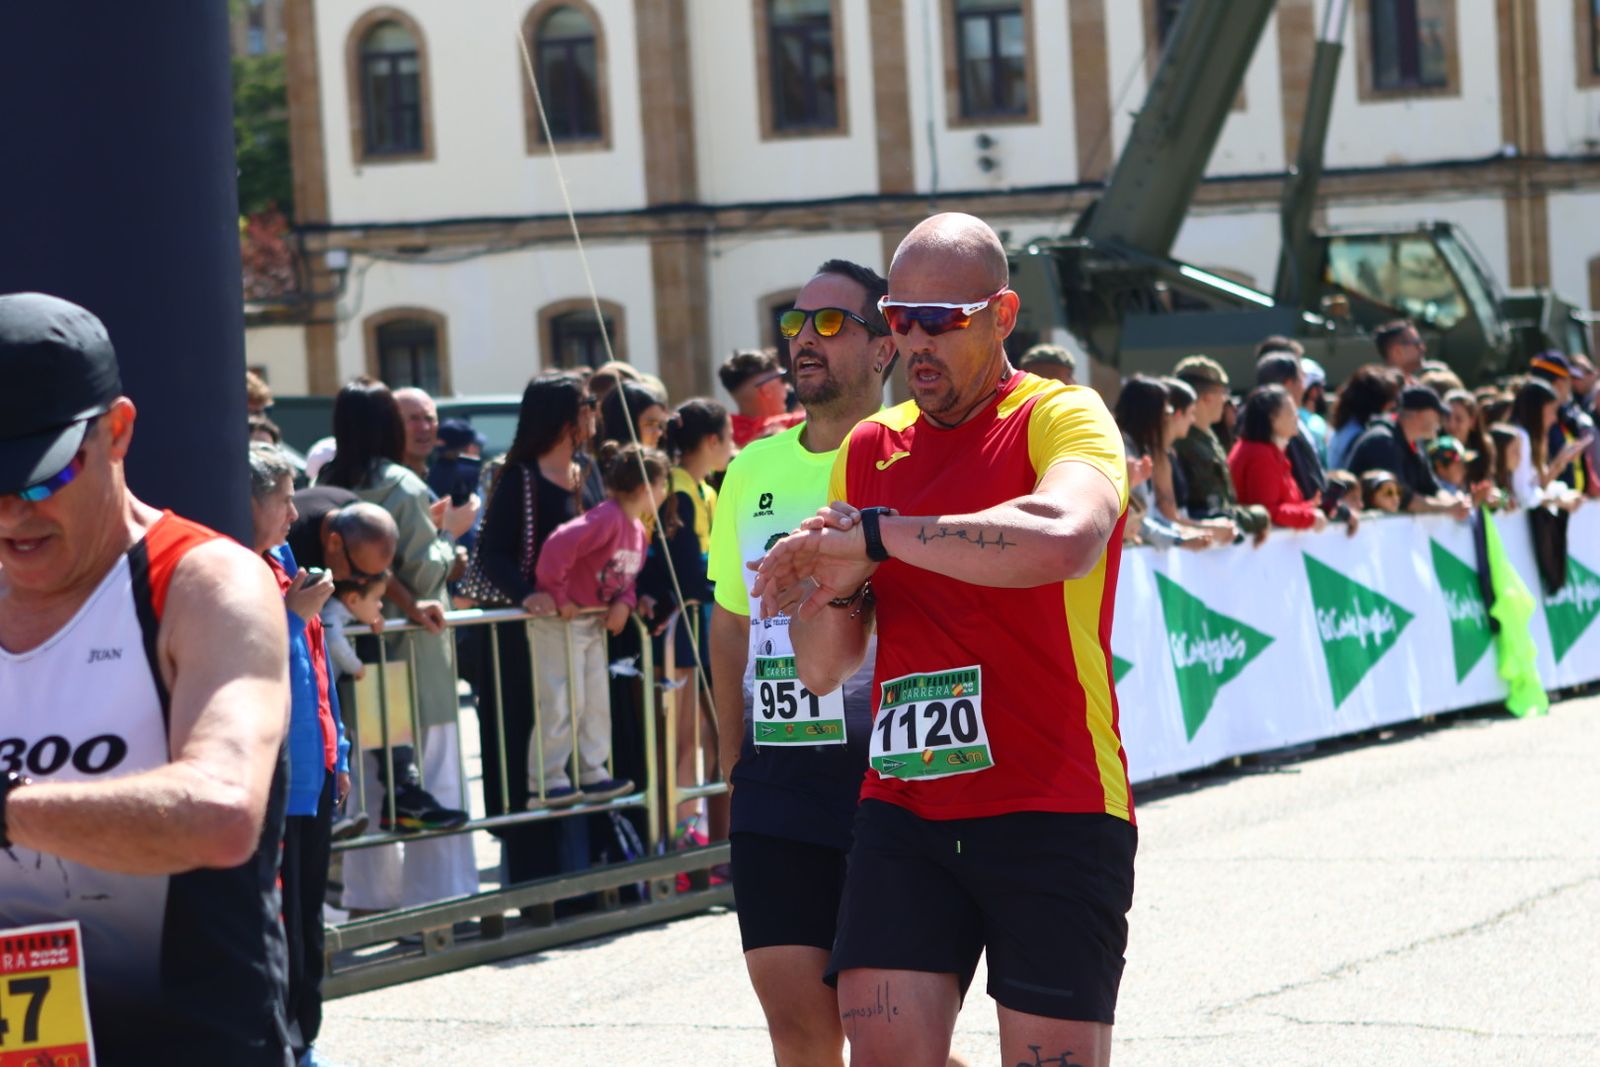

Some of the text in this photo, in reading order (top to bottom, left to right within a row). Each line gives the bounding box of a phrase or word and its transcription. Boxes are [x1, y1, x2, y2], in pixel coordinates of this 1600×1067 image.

[87, 648, 123, 664] JUAN
[766, 667, 794, 677] CARRE
[760, 681, 820, 719] 951
[902, 685, 950, 701] CARRERA
[877, 699, 979, 752] 1120
